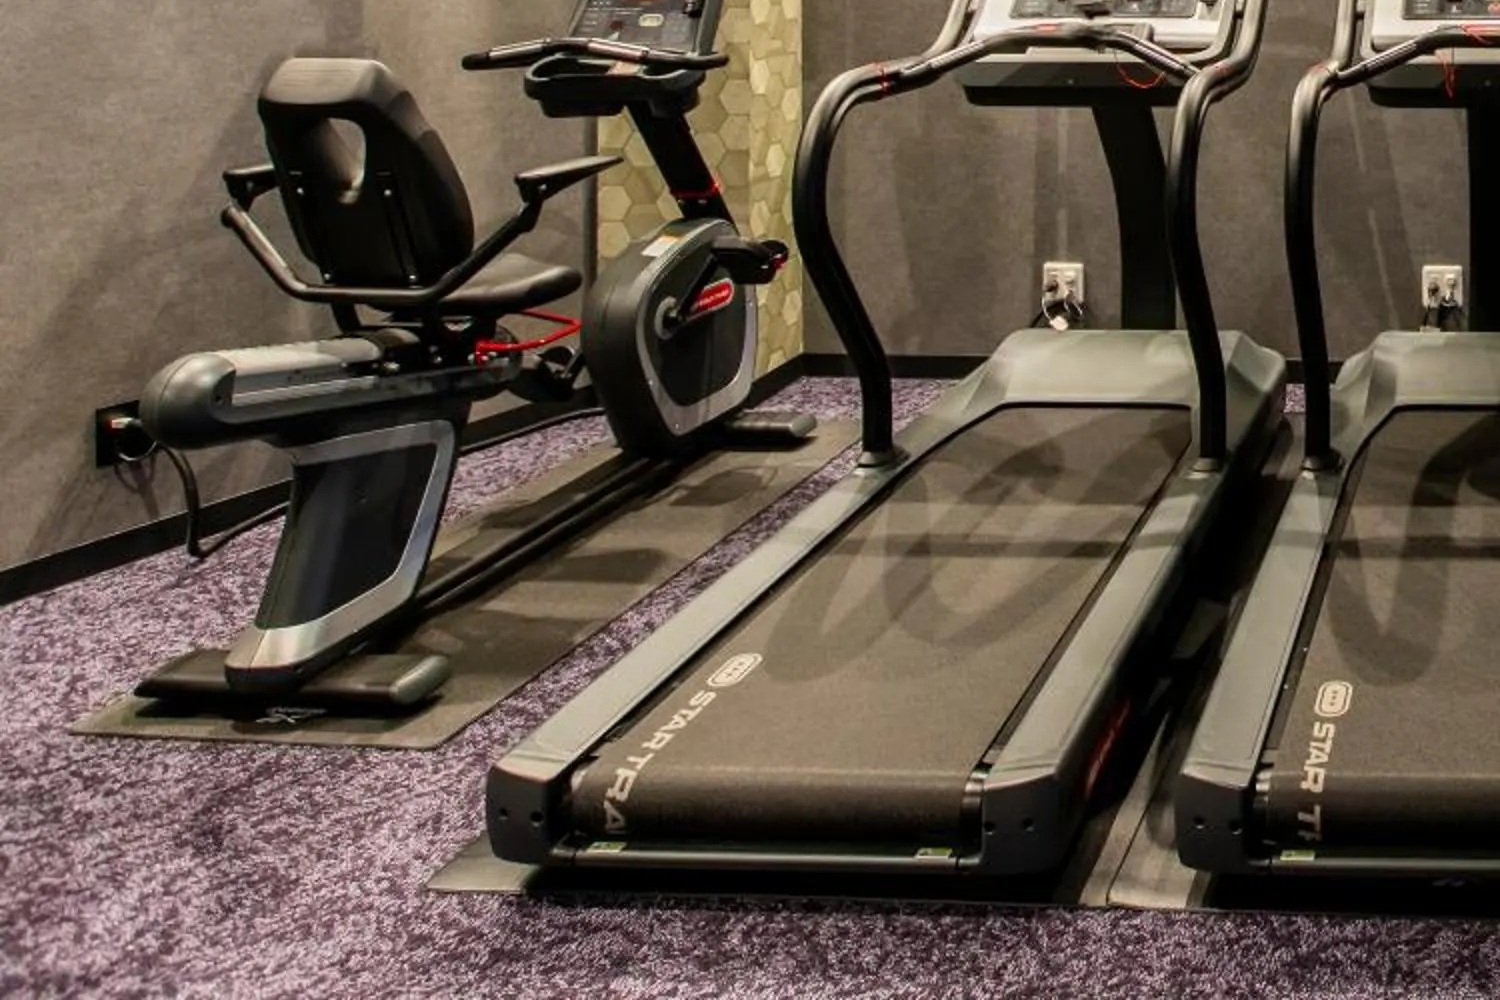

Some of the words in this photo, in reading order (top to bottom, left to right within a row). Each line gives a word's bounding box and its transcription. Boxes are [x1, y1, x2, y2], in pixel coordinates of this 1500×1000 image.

[642, 690, 717, 750] STAR
[604, 752, 655, 832] TRA
[1300, 721, 1336, 793] STAR
